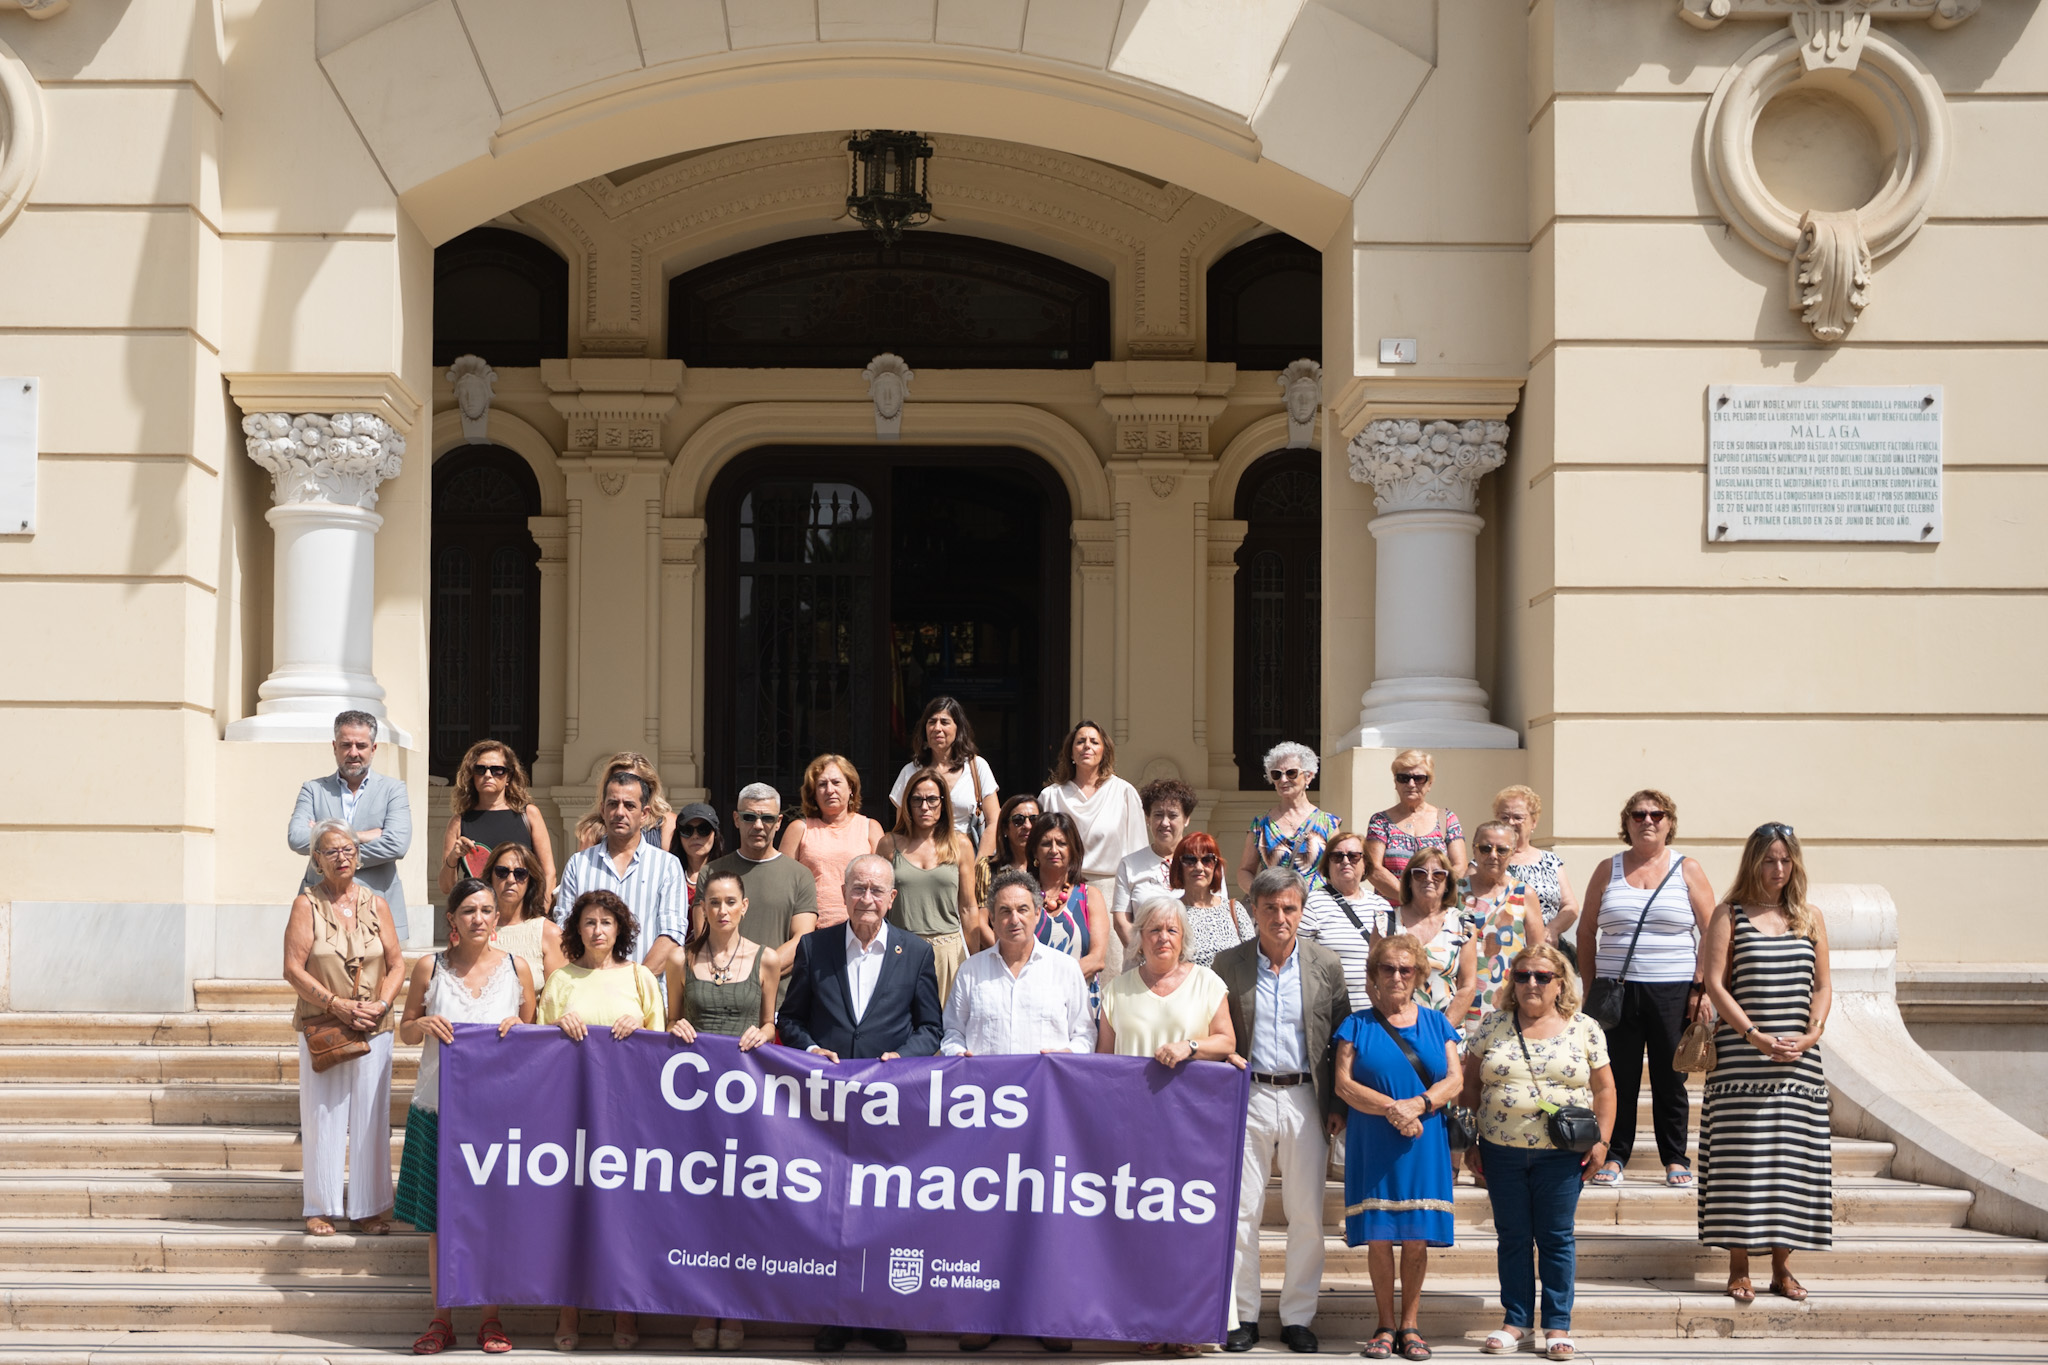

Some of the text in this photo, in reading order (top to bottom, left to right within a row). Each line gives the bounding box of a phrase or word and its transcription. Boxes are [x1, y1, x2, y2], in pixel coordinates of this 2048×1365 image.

[1394, 342, 1403, 358] 4
[1744, 400, 1760, 409] MUY
[1787, 400, 1801, 409] MUY
[1822, 400, 1850, 410] SIEMPRE
[1714, 412, 1721, 421] EN
[1723, 412, 1731, 421] EL
[1732, 412, 1757, 421] PELIGRO
[1758, 412, 1766, 421] DE
[1806, 413, 1819, 422] MUY
[1820, 413, 1861, 422] HOSPITALARIA
[1863, 413, 1867, 422] Y
[1867, 413, 1880, 422] MUY
[1909, 413, 1930, 422] CIUDAD
[1931, 413, 1938, 422] DE
[1713, 441, 1724, 450] FUE
[1726, 441, 1735, 450] EN
[1736, 441, 1744, 450] SU
[1745, 441, 1768, 450] ORIGEN
[1769, 441, 1777, 450] UN
[1778, 441, 1806, 450] POBLADO
[1834, 441, 1839, 451] Y
[1840, 441, 1886, 451] SUCESIVAMENTE
[1713, 453, 1740, 463] EMPORIO
[1777, 453, 1807, 463] MUNICIPIO
[1809, 453, 1816, 463] AL
[1817, 453, 1829, 464] QUE
[1831, 453, 1862, 463] DOMICIANO
[1893, 453, 1904, 463] UNA
[1714, 466, 1719, 475] Y
[1720, 466, 1739, 475] LUEGO
[1741, 466, 1770, 475] VISIGODA
[1771, 466, 1775, 475] Y
[1809, 466, 1813, 475] Y
[1814, 466, 1839, 475] PUERTO
[1840, 466, 1852, 475] DEL
[1854, 466, 1873, 475] ISLAM
[1875, 466, 1891, 475] BAJO
[1901, 465, 1938, 475] DOMINACIÓN
[1755, 479, 1773, 487] ENTRE
[1775, 479, 1782, 487] EL
[1783, 477, 1827, 488] MEDITERRÁNEO
[1828, 479, 1832, 488] Y
[1833, 479, 1840, 488] EL
[1872, 479, 1889, 488] ENTRE
[1890, 479, 1912, 488] EUROPA
[1912, 479, 1916, 488] Y
[1917, 477, 1938, 488] ÁFRICA.
[1714, 491, 1724, 500] LOS
[1726, 491, 1743, 500] REYES
[1783, 491, 1824, 501] CONQUISTARON
[1825, 491, 1832, 500] EN
[1833, 491, 1854, 500] AGOSTO
[1855, 491, 1862, 500] DE
[1862, 491, 1875, 500] 1487
[1876, 491, 1880, 500] Y
[1881, 491, 1892, 500] POR
[1893, 491, 1903, 500] SUS
[1904, 491, 1938, 500] ORDENANZAS
[1716, 504, 1724, 513] DE
[1726, 504, 1734, 513] 27
[1736, 504, 1744, 513] DE
[1746, 504, 1764, 513] MAYO
[1765, 504, 1773, 513] DE
[1774, 504, 1789, 513] 1489
[1791, 504, 1835, 513] INSTITUYERON
[1836, 504, 1844, 513] SU
[1893, 504, 1905, 514] QUE
[1743, 515, 1912, 526] EL PRIMER CABILDO EN 26 DE JUNIO DE DICHO AÑO.
[661, 1052, 1029, 1129] Contra las
[460, 1128, 1216, 1224] violencias machistas
[668, 1249, 836, 1276] Ciudad de Igualdad
[931, 1259, 980, 1272] Ciudad
[930, 1274, 1000, 1291] de Málaga
